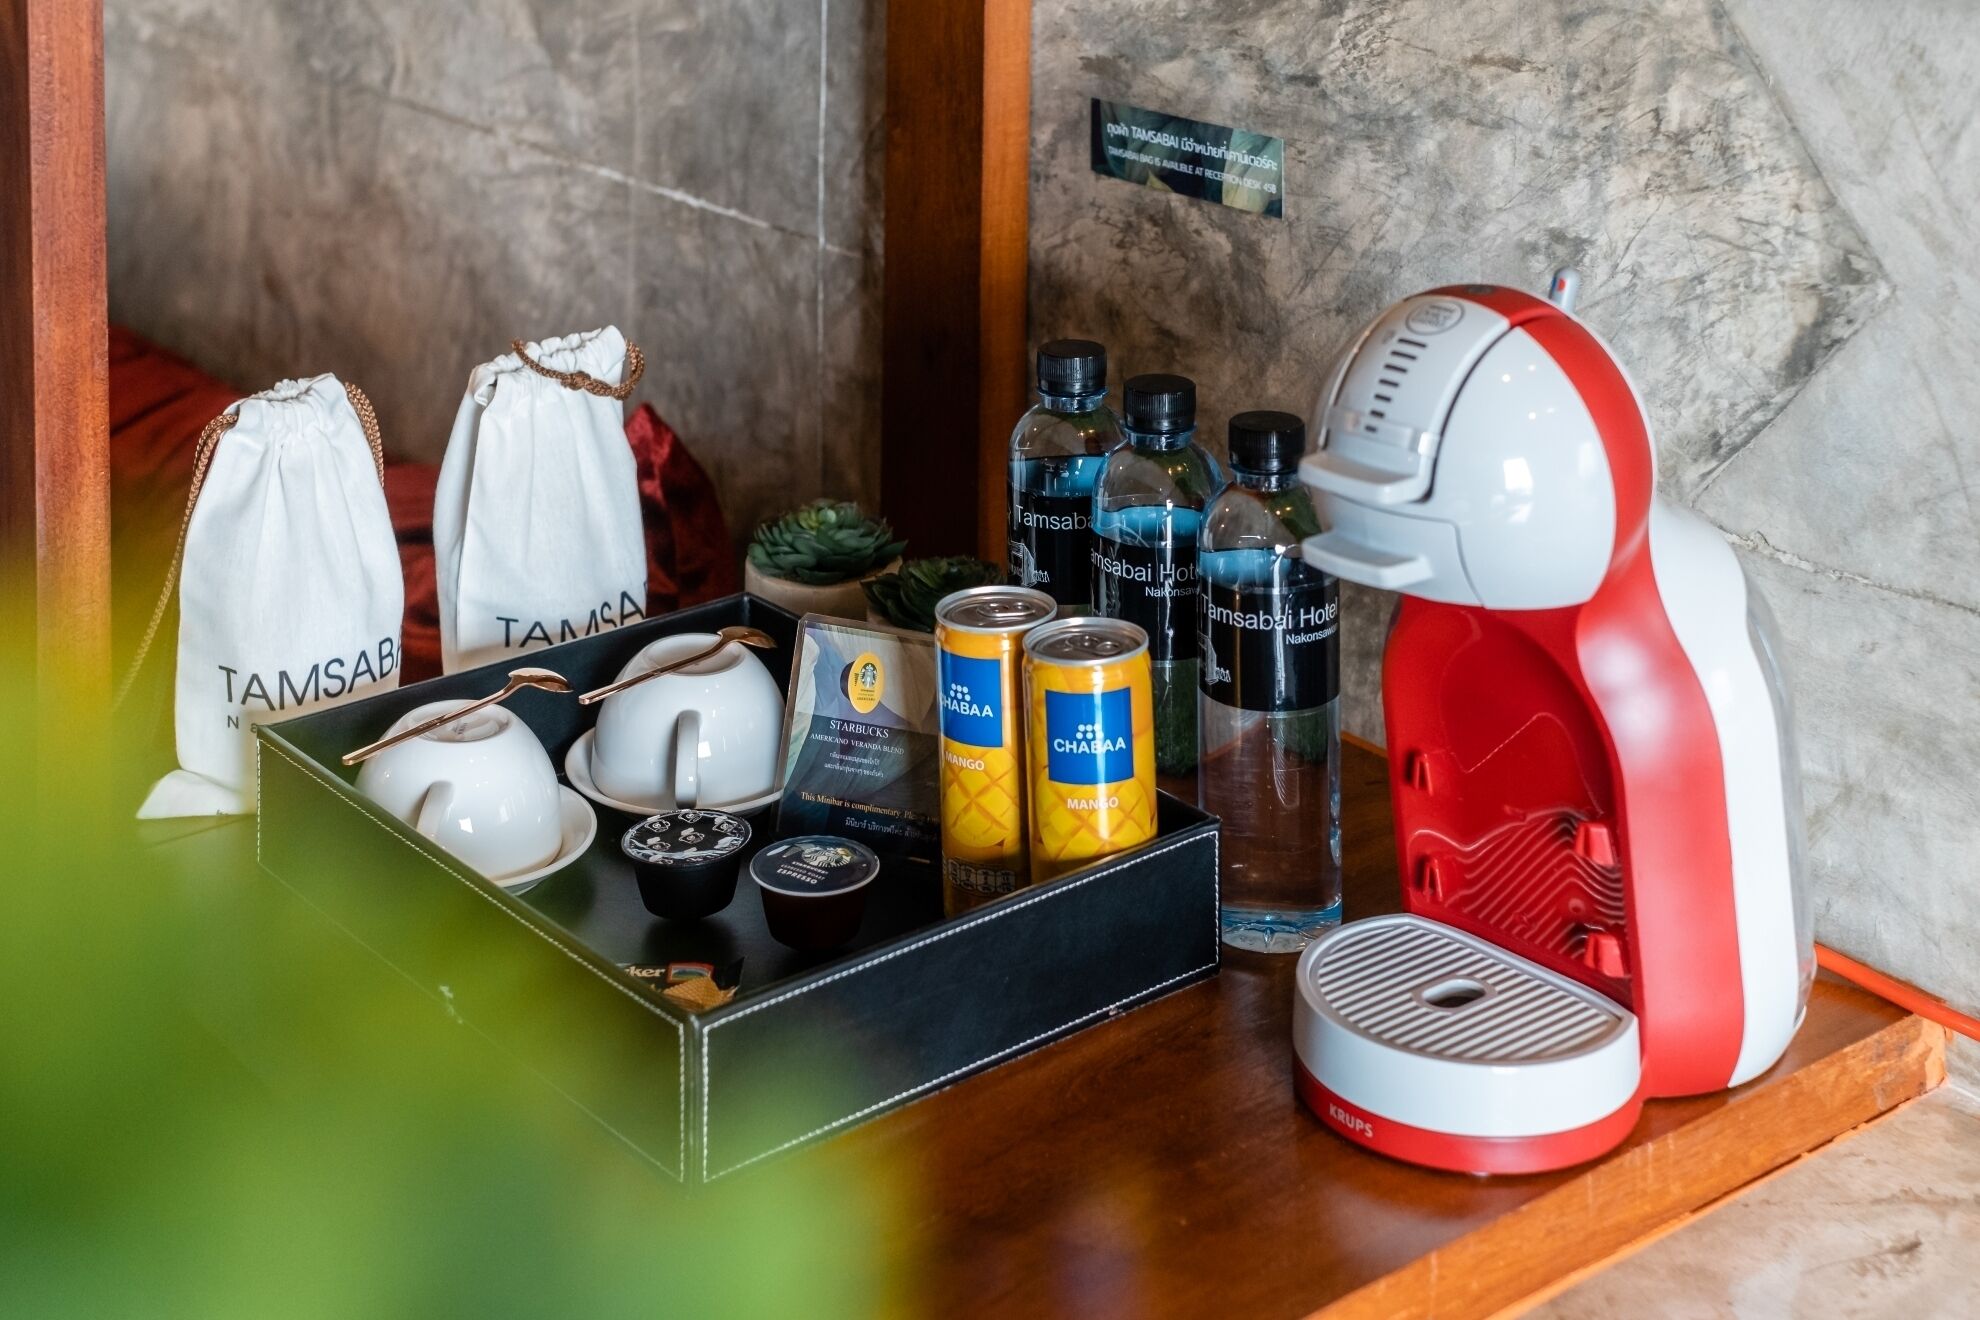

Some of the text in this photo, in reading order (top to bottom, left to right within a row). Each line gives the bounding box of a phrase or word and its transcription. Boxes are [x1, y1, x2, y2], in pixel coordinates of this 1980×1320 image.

[1131, 126, 1178, 148] TAMSABAI
[1140, 153, 1153, 165] BAG
[1194, 166, 1204, 176] AT
[1204, 169, 1242, 186] RECEPTION
[1243, 178, 1262, 191] DESK
[1202, 593, 1338, 631] Tamsabai Hotel
[829, 719, 889, 739] STARBUCKS
[851, 739, 882, 752] VERANDA
[882, 745, 904, 755] BLEND
[1053, 737, 1127, 755] CHABAA
[945, 750, 985, 771] MANGO
[801, 792, 816, 802] This
[816, 794, 843, 807] Minibar
[844, 800, 851, 808] is
[1067, 796, 1119, 811] MANGO
[777, 868, 817, 884] ESPRESSO
[1329, 1103, 1374, 1138] KRUPS
